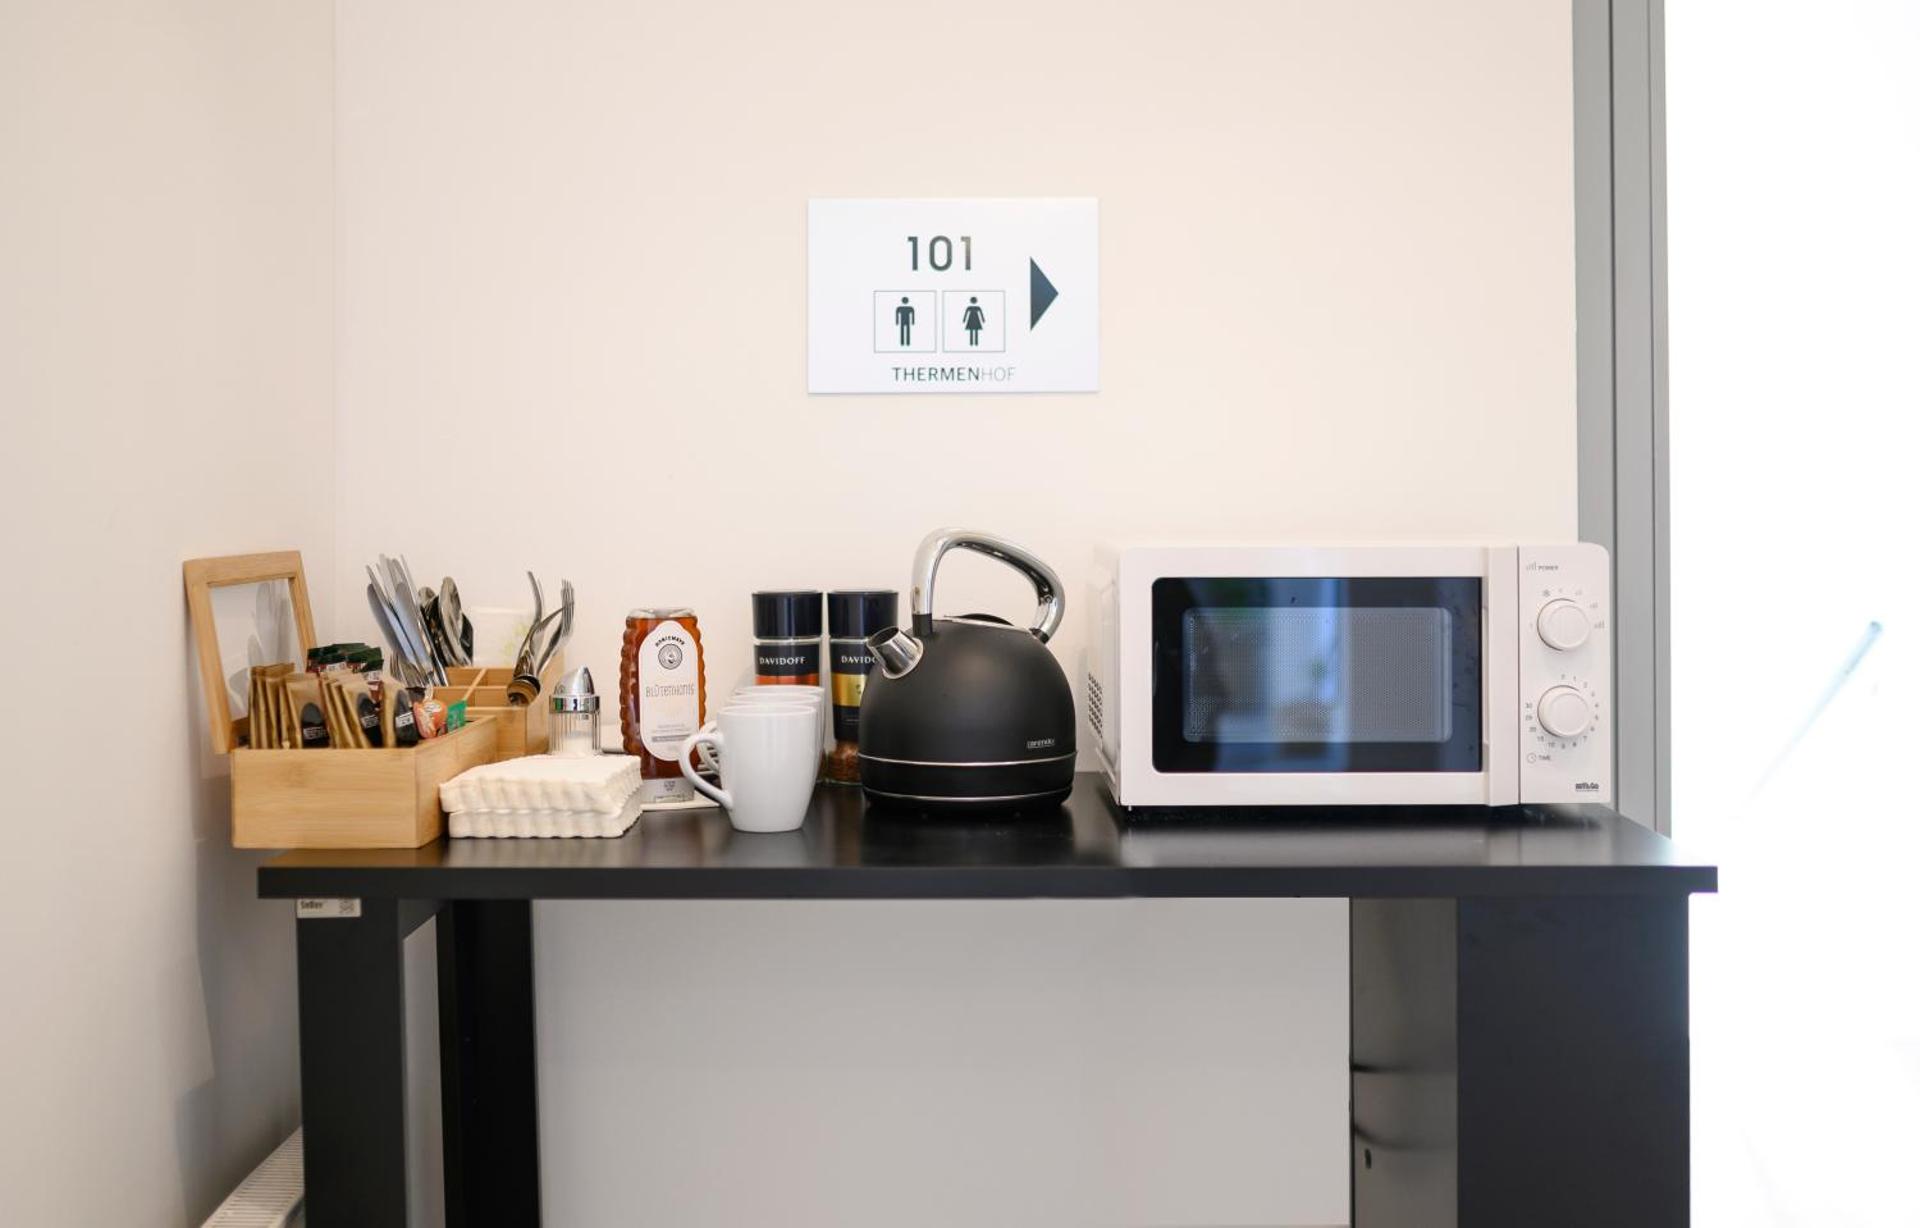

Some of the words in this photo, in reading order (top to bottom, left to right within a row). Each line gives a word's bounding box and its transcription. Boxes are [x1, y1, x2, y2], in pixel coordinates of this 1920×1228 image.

[907, 235, 972, 272] 101
[892, 366, 1017, 382] THERMENHOF
[759, 655, 807, 666] DAVIDOFF
